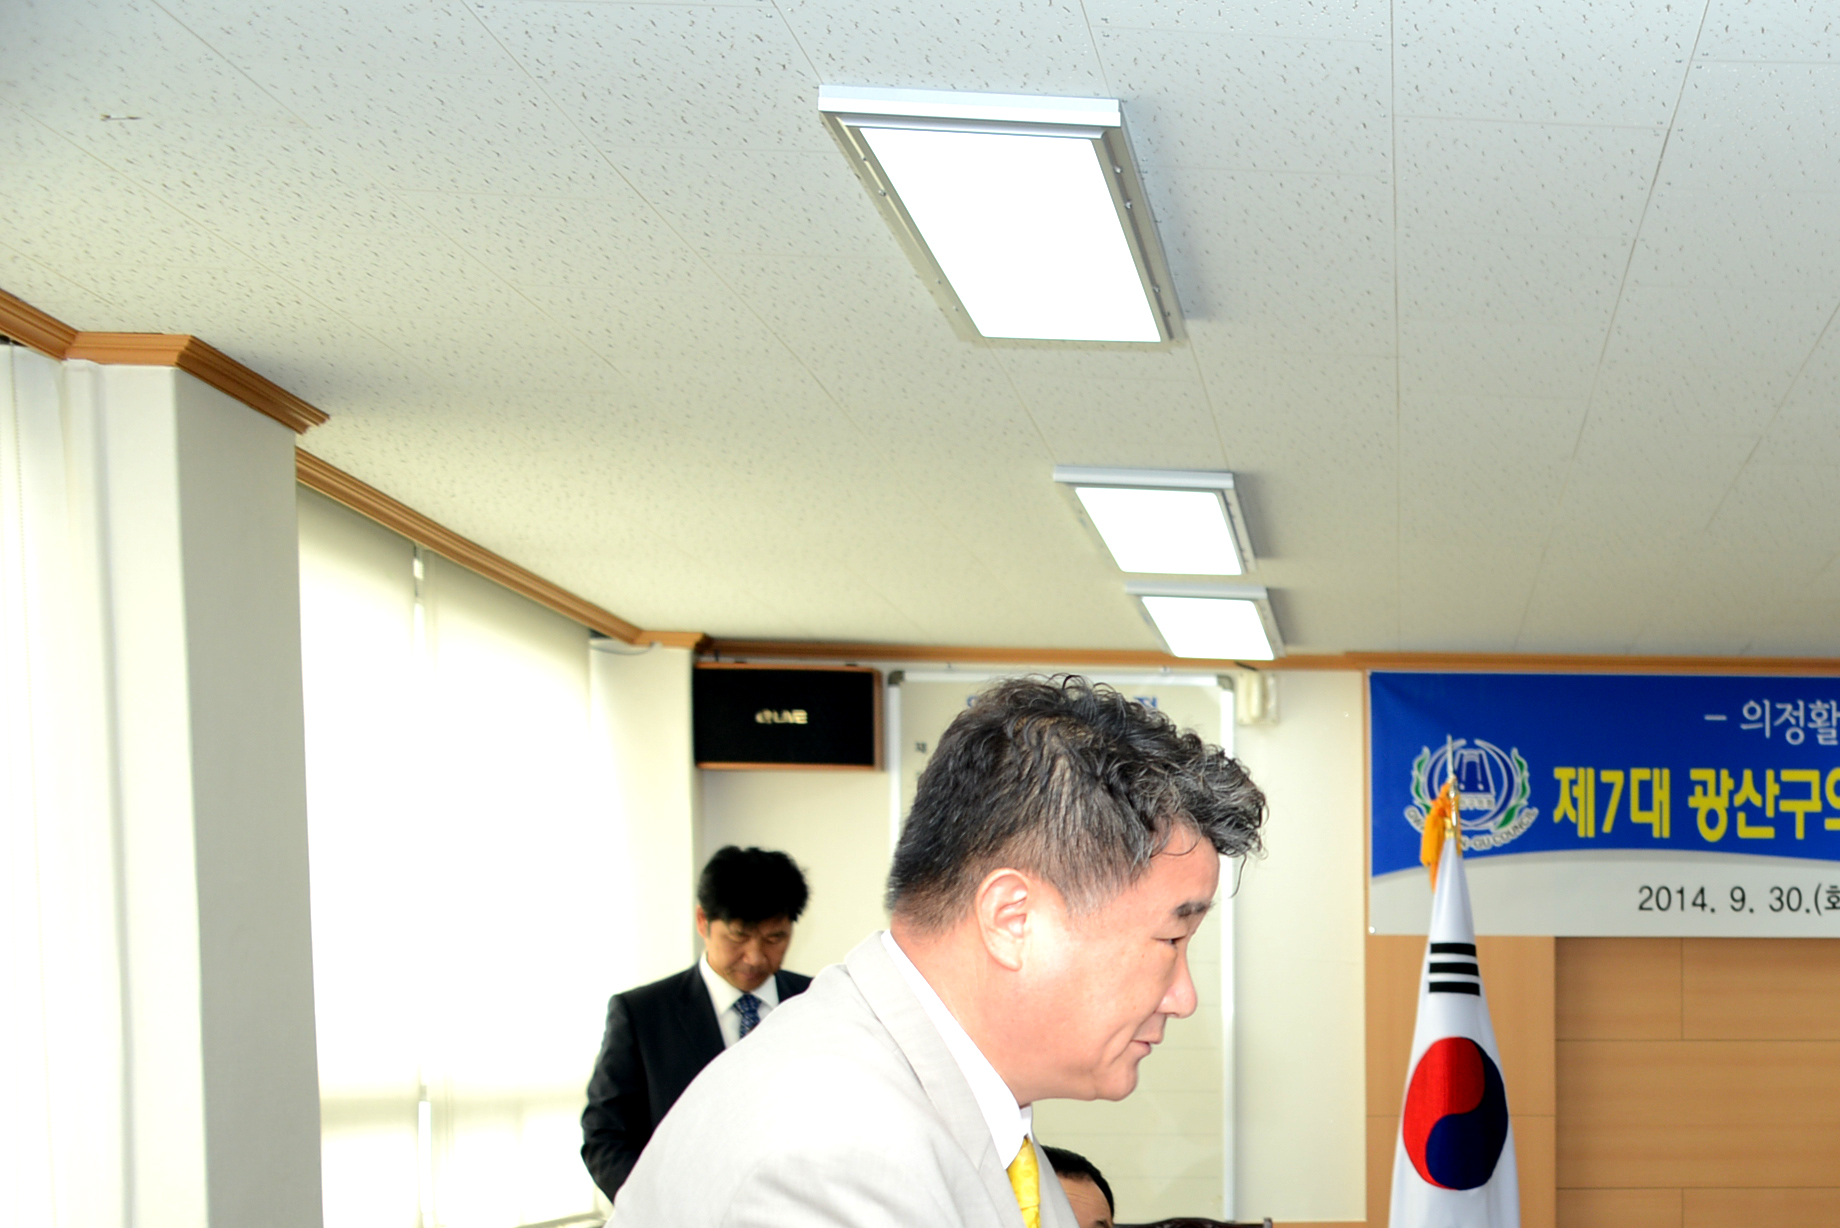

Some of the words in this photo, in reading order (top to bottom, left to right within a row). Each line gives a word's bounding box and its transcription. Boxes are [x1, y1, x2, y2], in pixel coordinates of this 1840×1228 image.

[1552, 766, 1671, 839] 제7대
[1638, 885, 1716, 914] 2014.
[1730, 886, 1755, 914] 9.
